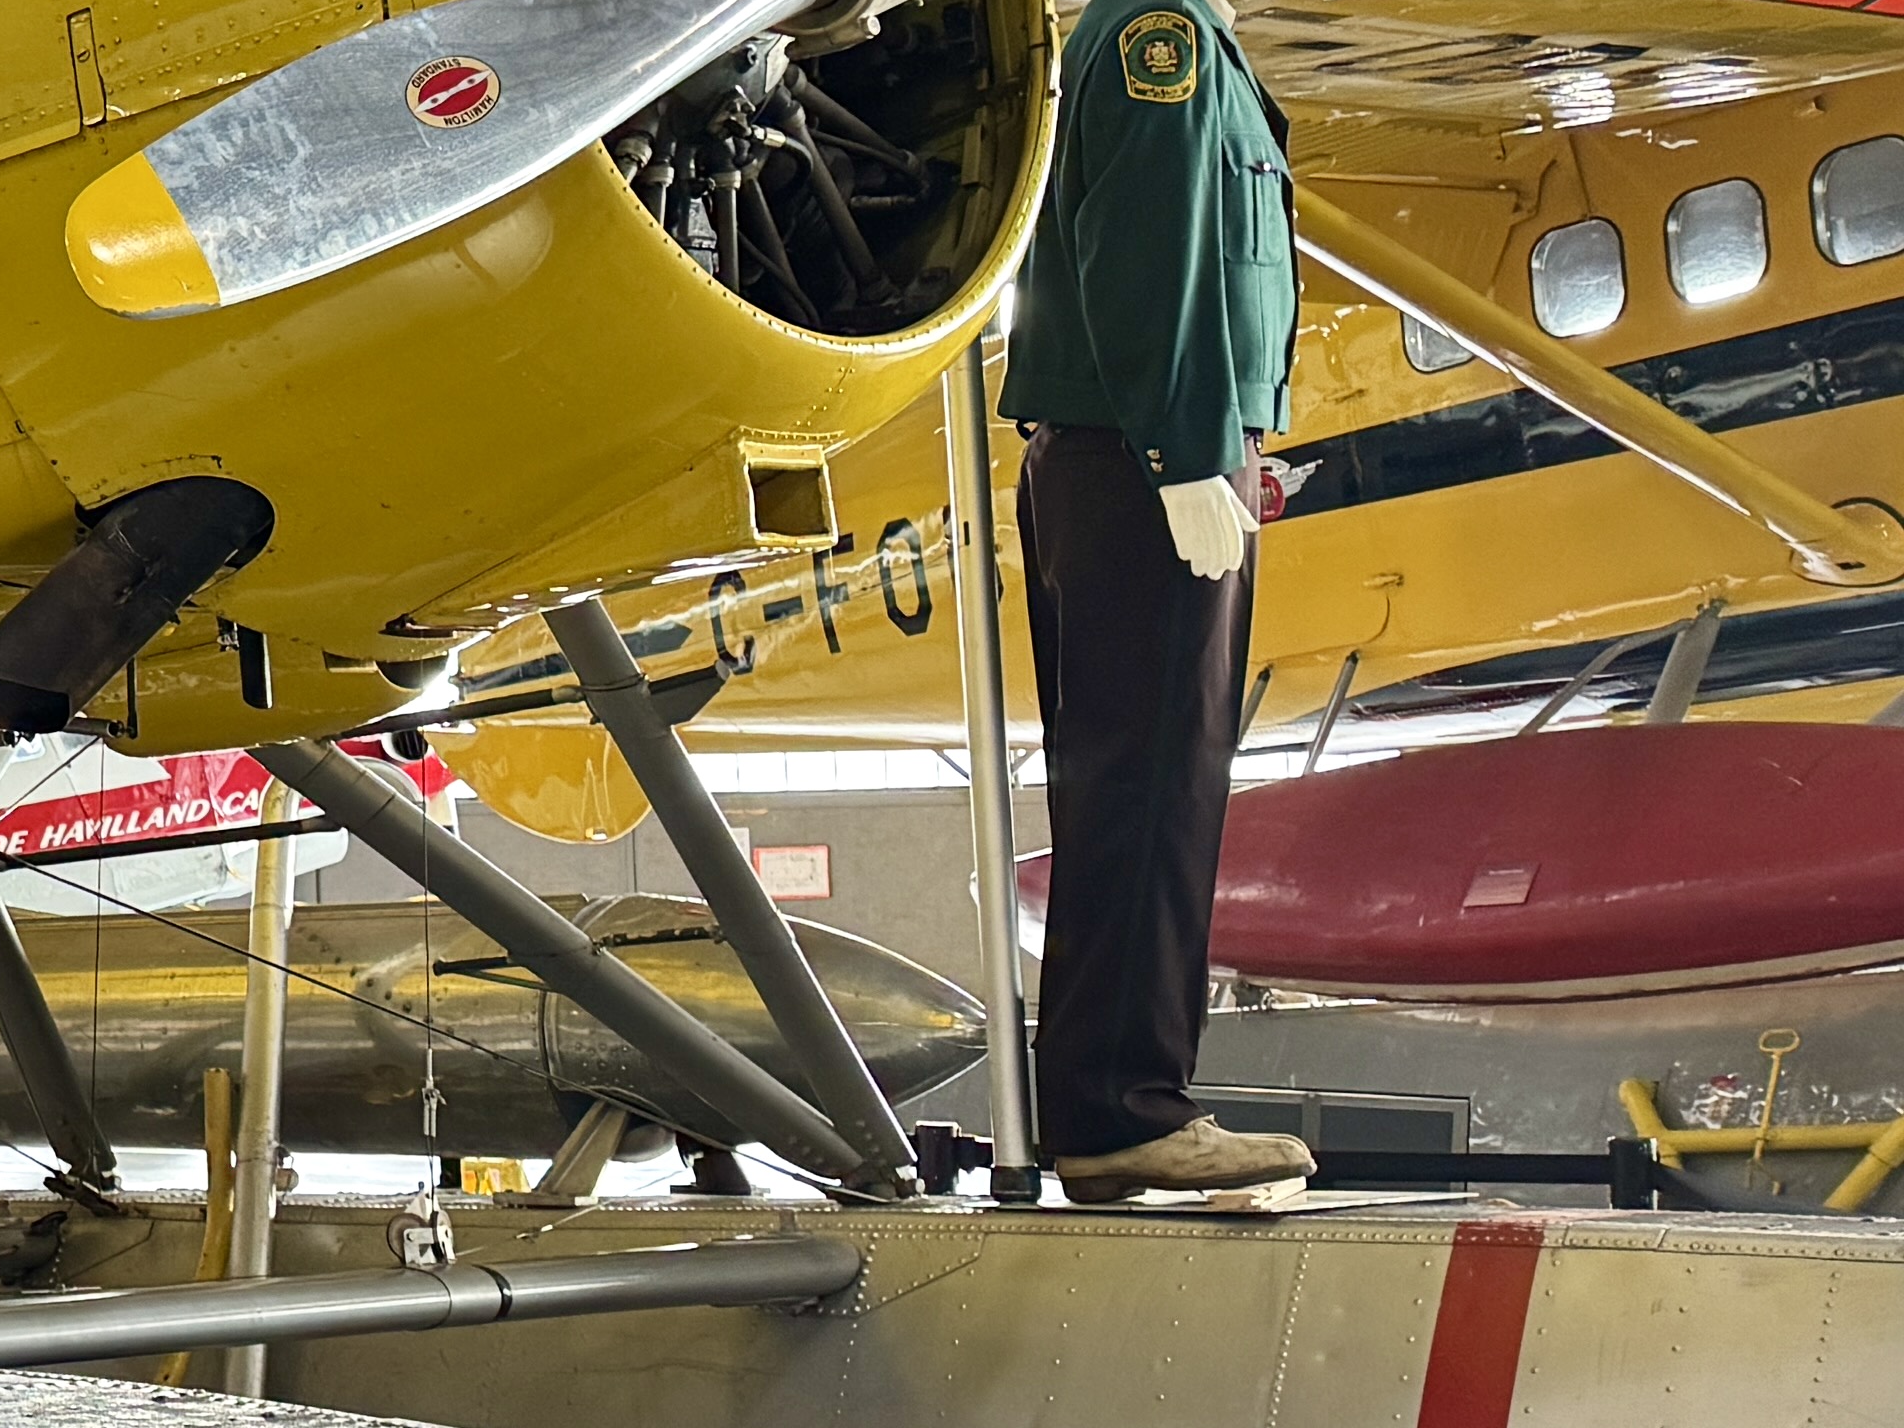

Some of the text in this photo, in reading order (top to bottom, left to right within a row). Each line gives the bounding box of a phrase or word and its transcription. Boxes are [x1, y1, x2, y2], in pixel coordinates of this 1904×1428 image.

[411, 58, 462, 89] STANDARD
[443, 94, 494, 127] HAMILTON
[708, 503, 1004, 676] C-FO
[40, 798, 210, 850] HAVILLAND
